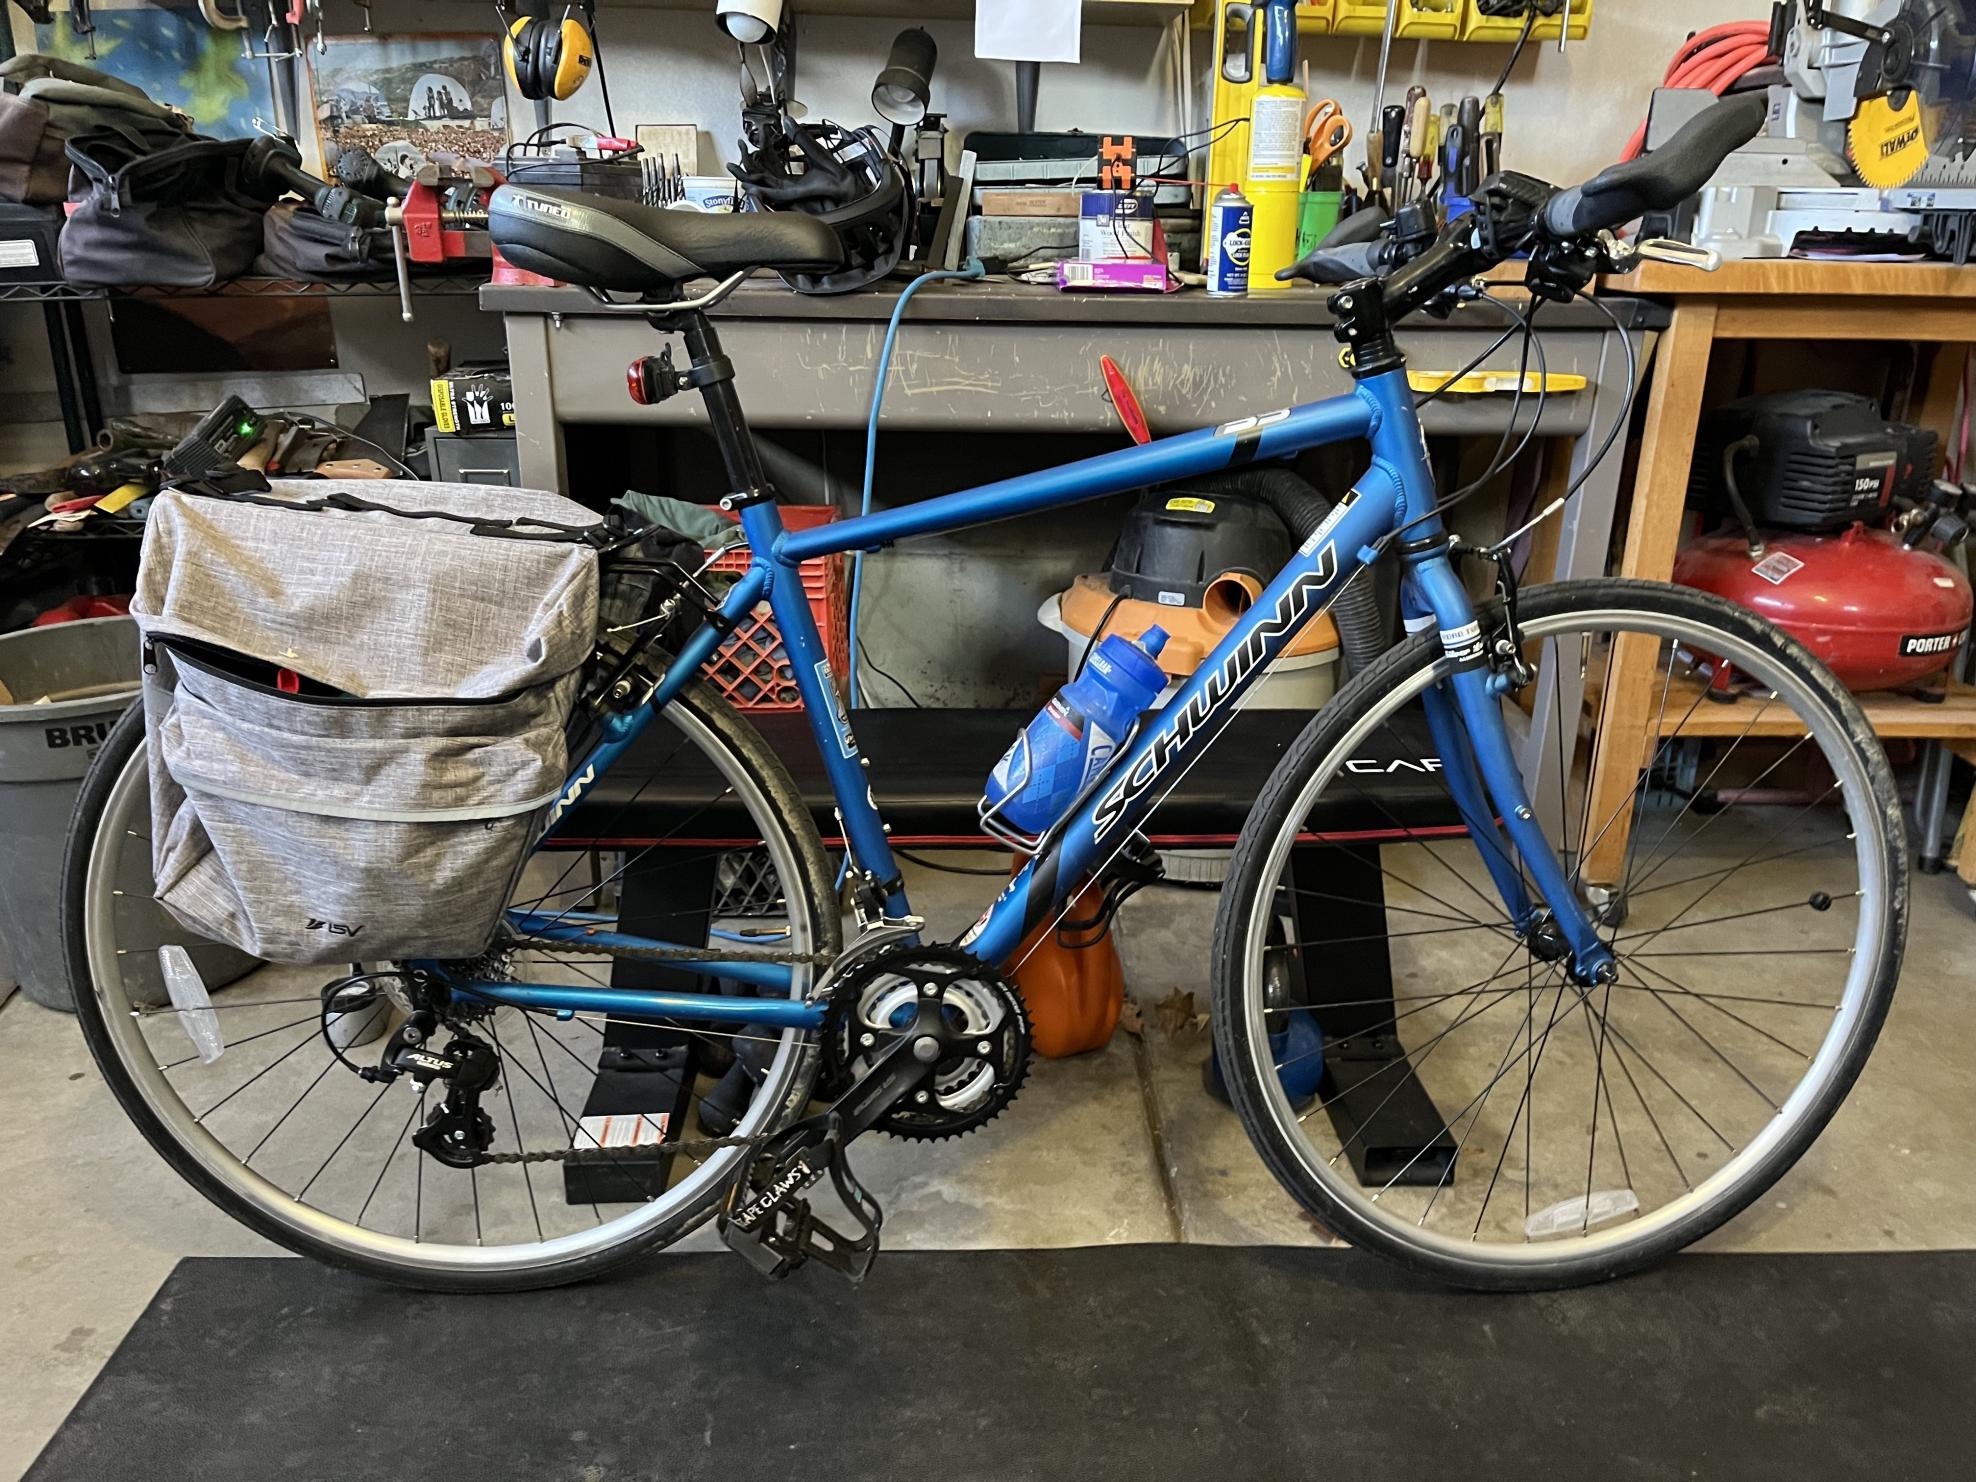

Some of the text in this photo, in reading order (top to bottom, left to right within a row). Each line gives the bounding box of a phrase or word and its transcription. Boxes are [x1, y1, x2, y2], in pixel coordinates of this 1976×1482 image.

[500, 402, 514, 411] 10
[1906, 635, 1951, 653] PORTER
[1092, 539, 1338, 845] SCHWINN
[406, 1053, 454, 1069] ALTUS
